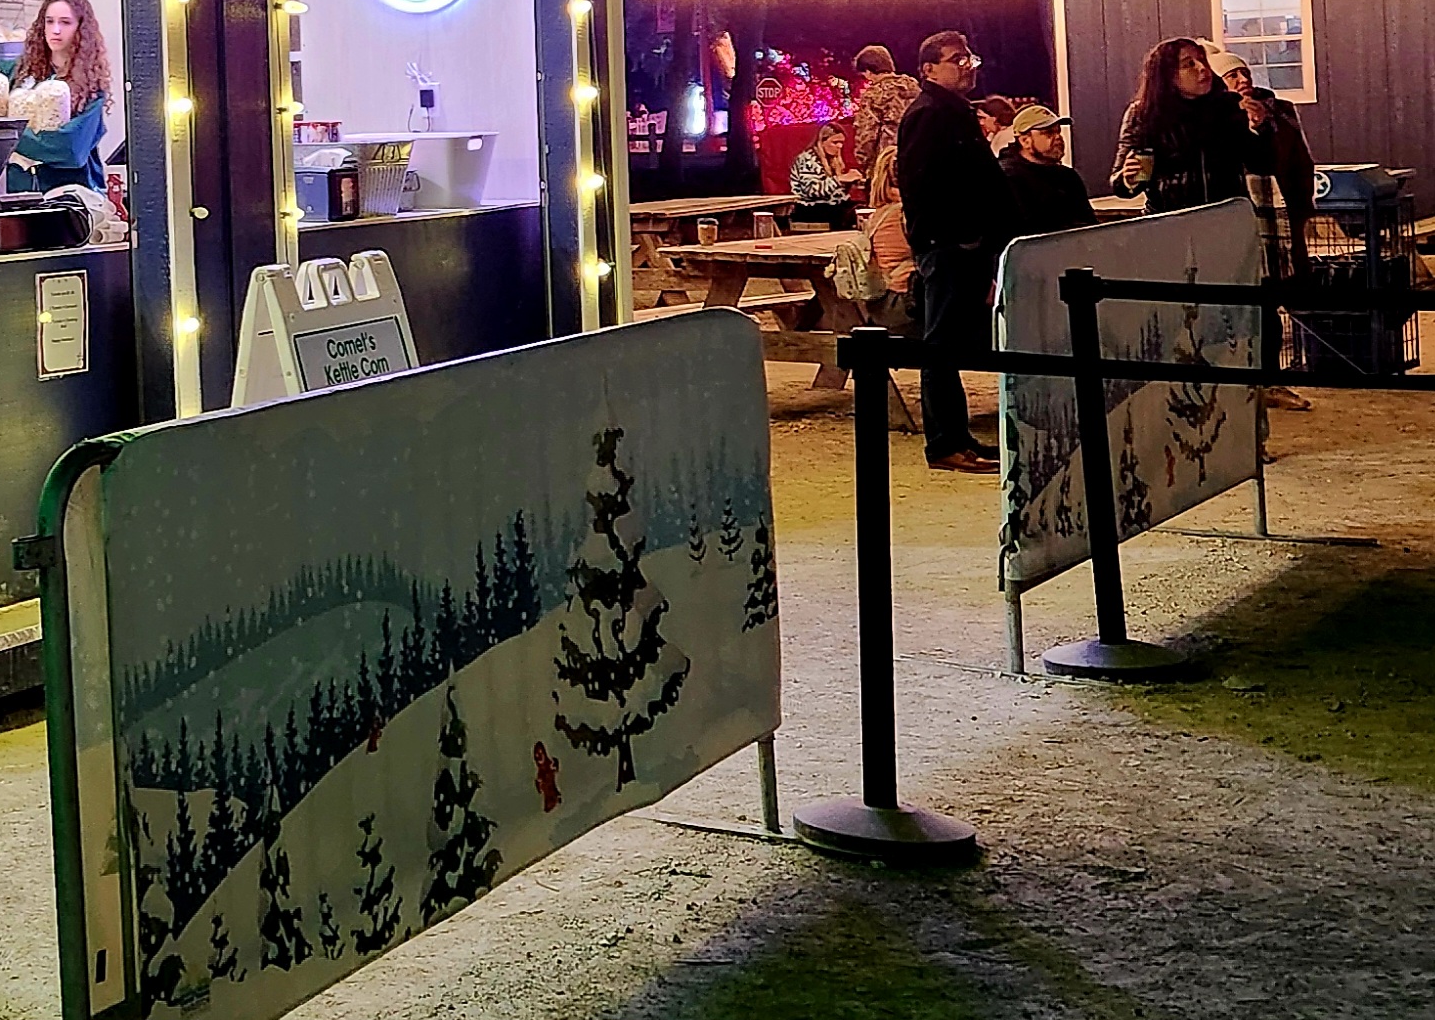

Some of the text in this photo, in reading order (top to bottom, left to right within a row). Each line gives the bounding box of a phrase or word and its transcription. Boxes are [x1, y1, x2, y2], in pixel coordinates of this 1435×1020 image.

[758, 87, 781, 99] STOP
[326, 332, 377, 359] Comet's
[324, 357, 390, 385] Kettle Corn
